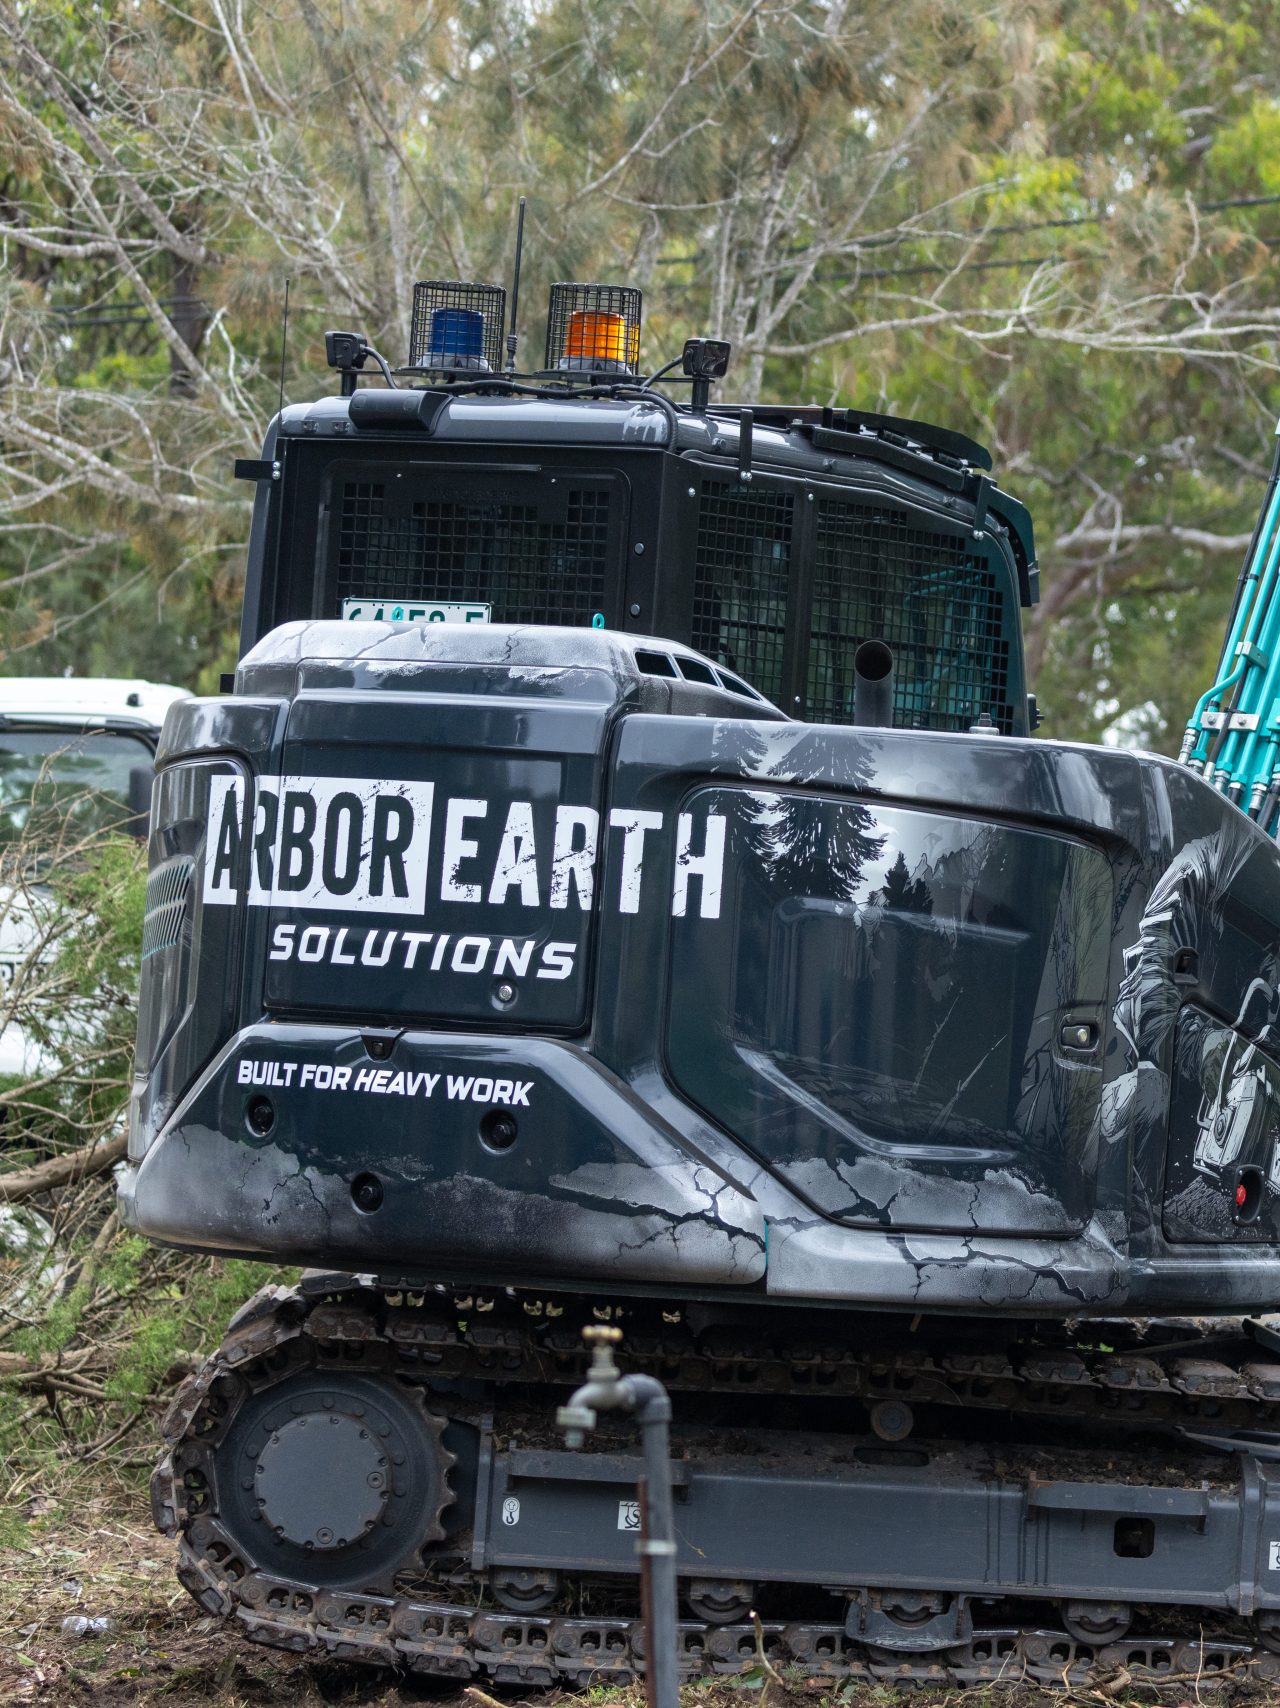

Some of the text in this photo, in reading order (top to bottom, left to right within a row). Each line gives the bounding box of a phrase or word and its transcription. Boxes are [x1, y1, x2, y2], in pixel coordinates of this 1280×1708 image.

[209, 786, 728, 919] ARBOR EARTH
[269, 924, 577, 980] SOLUTIONS
[237, 1060, 534, 1106] BUILT FOR HEAVY WORK
